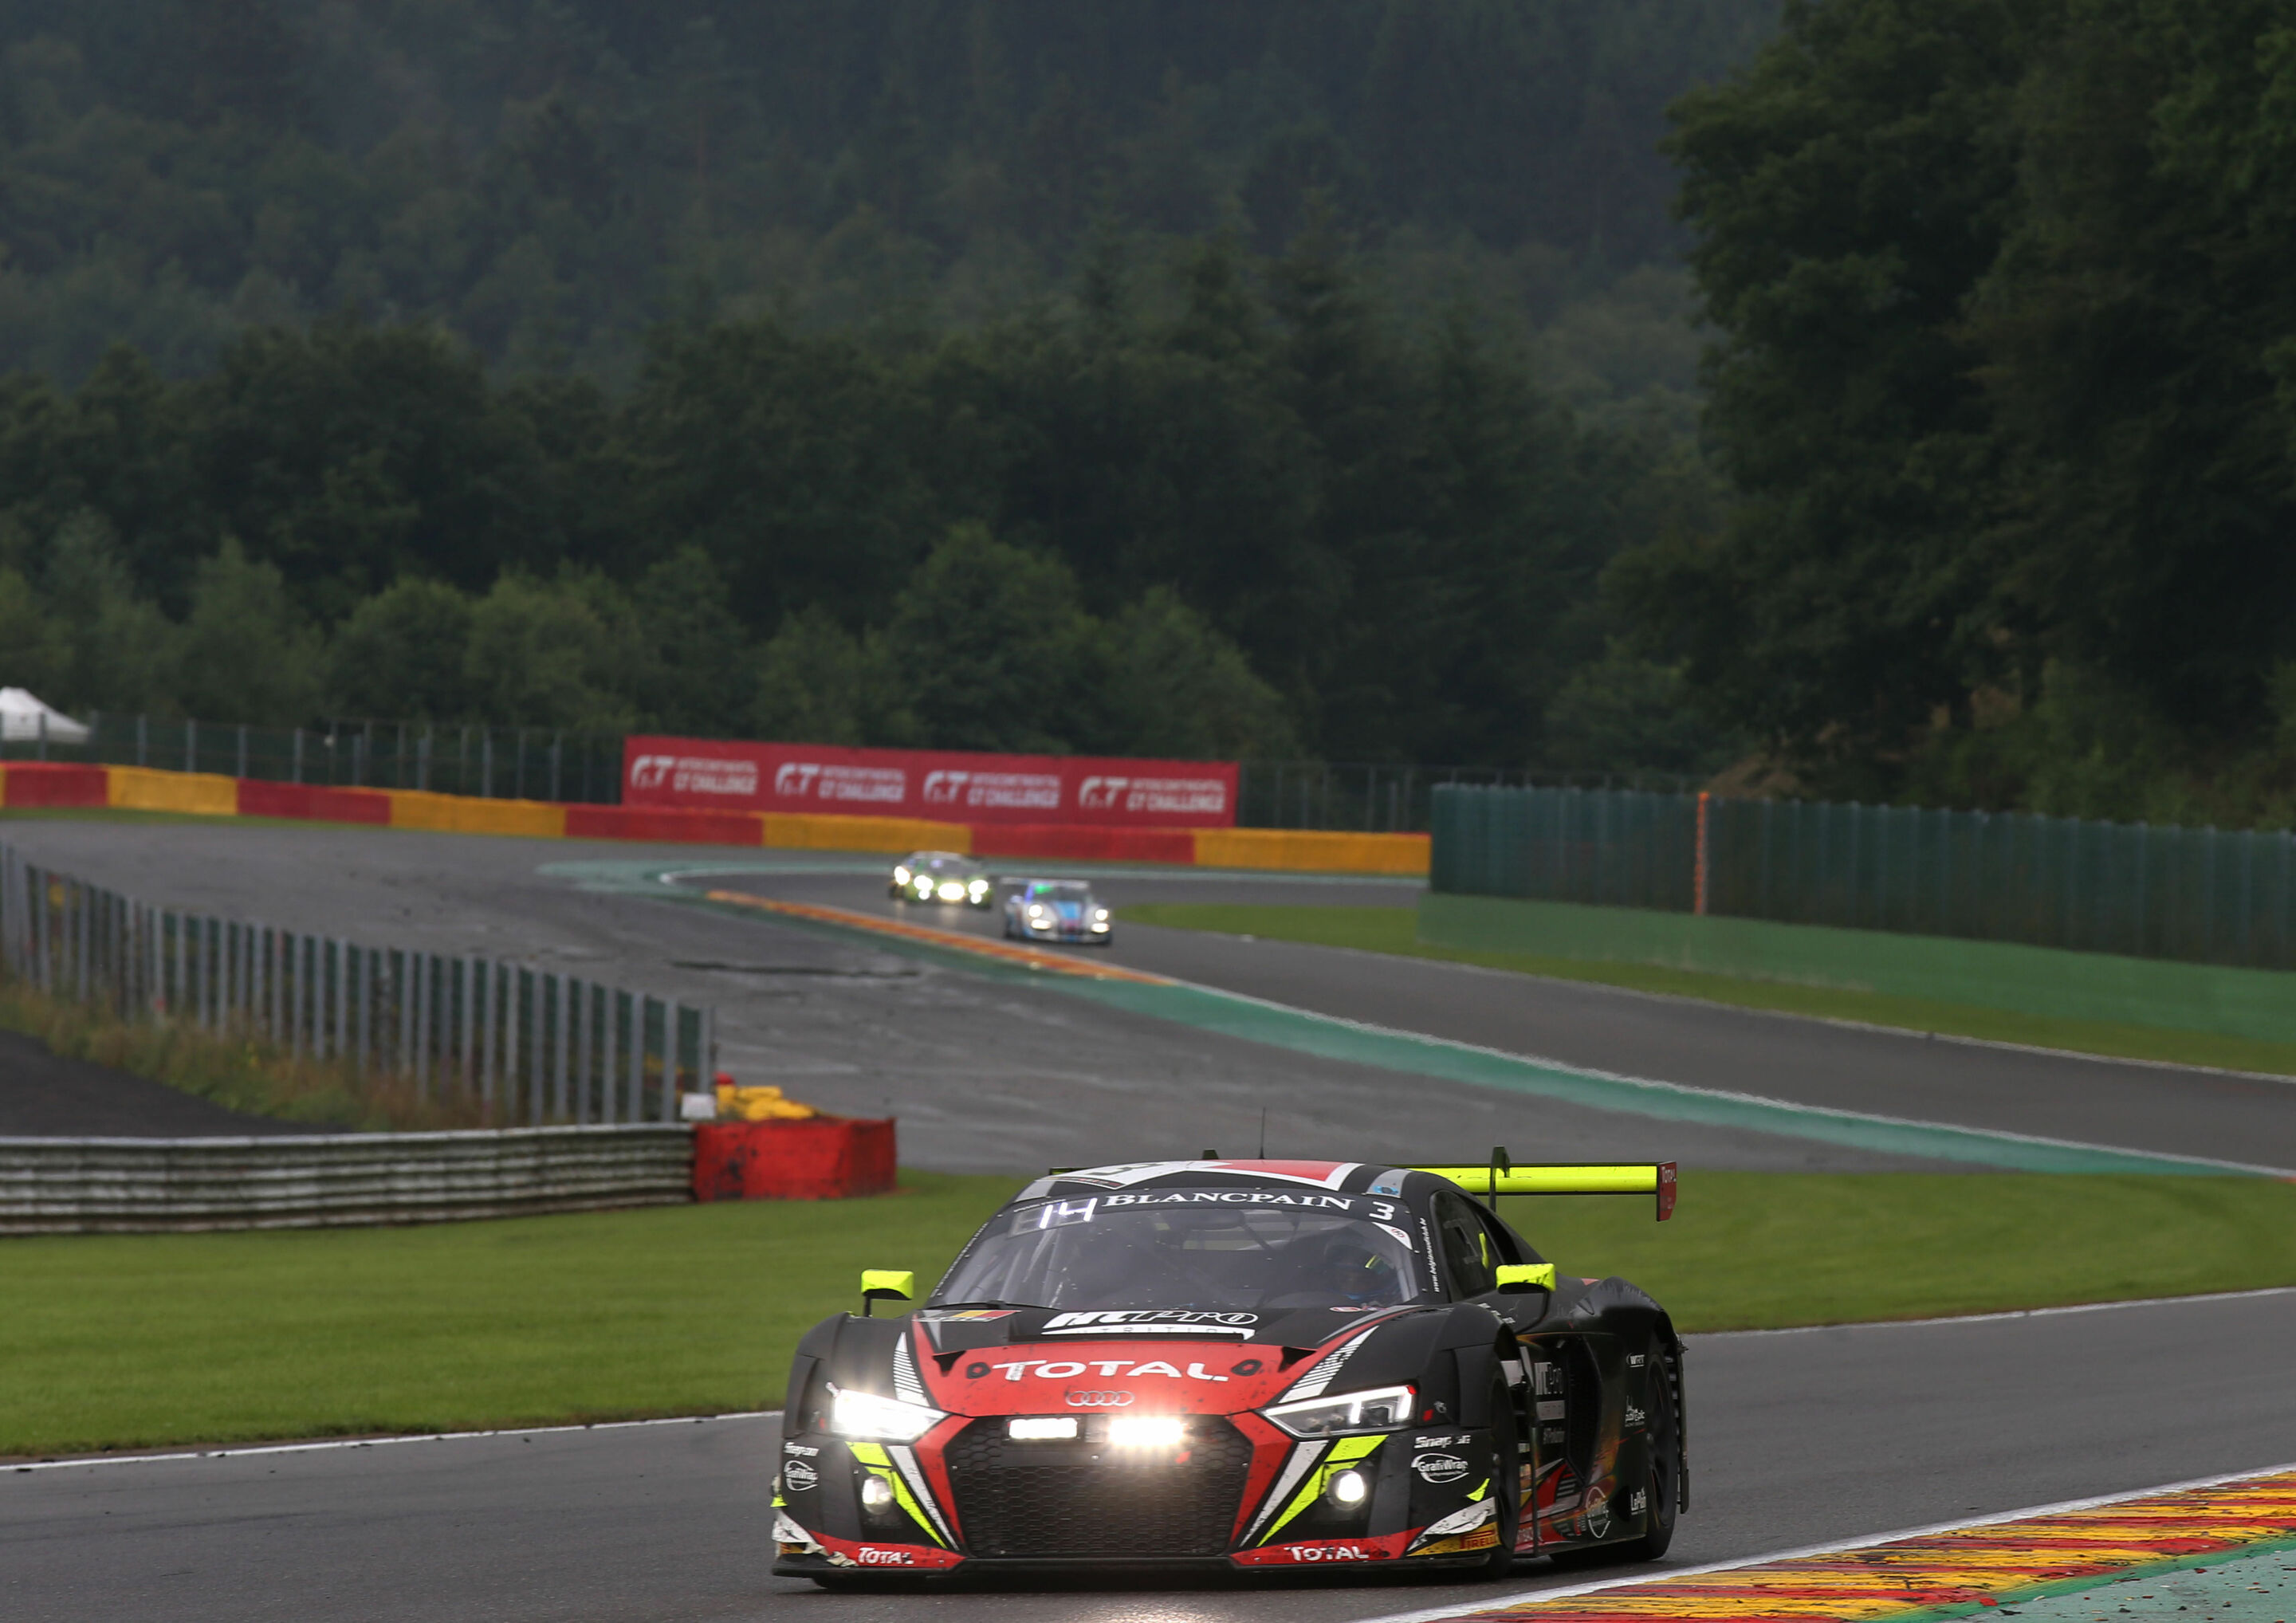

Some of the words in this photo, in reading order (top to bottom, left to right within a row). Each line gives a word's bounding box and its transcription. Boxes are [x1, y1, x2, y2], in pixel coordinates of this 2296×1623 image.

[1102, 1193, 1355, 1211] BLANCPAIN
[1369, 1201, 1395, 1220] 3
[1039, 1197, 1098, 1229] 14
[993, 1360, 1229, 1381] TOTAL
[1284, 1546, 1370, 1562] TOTAL
